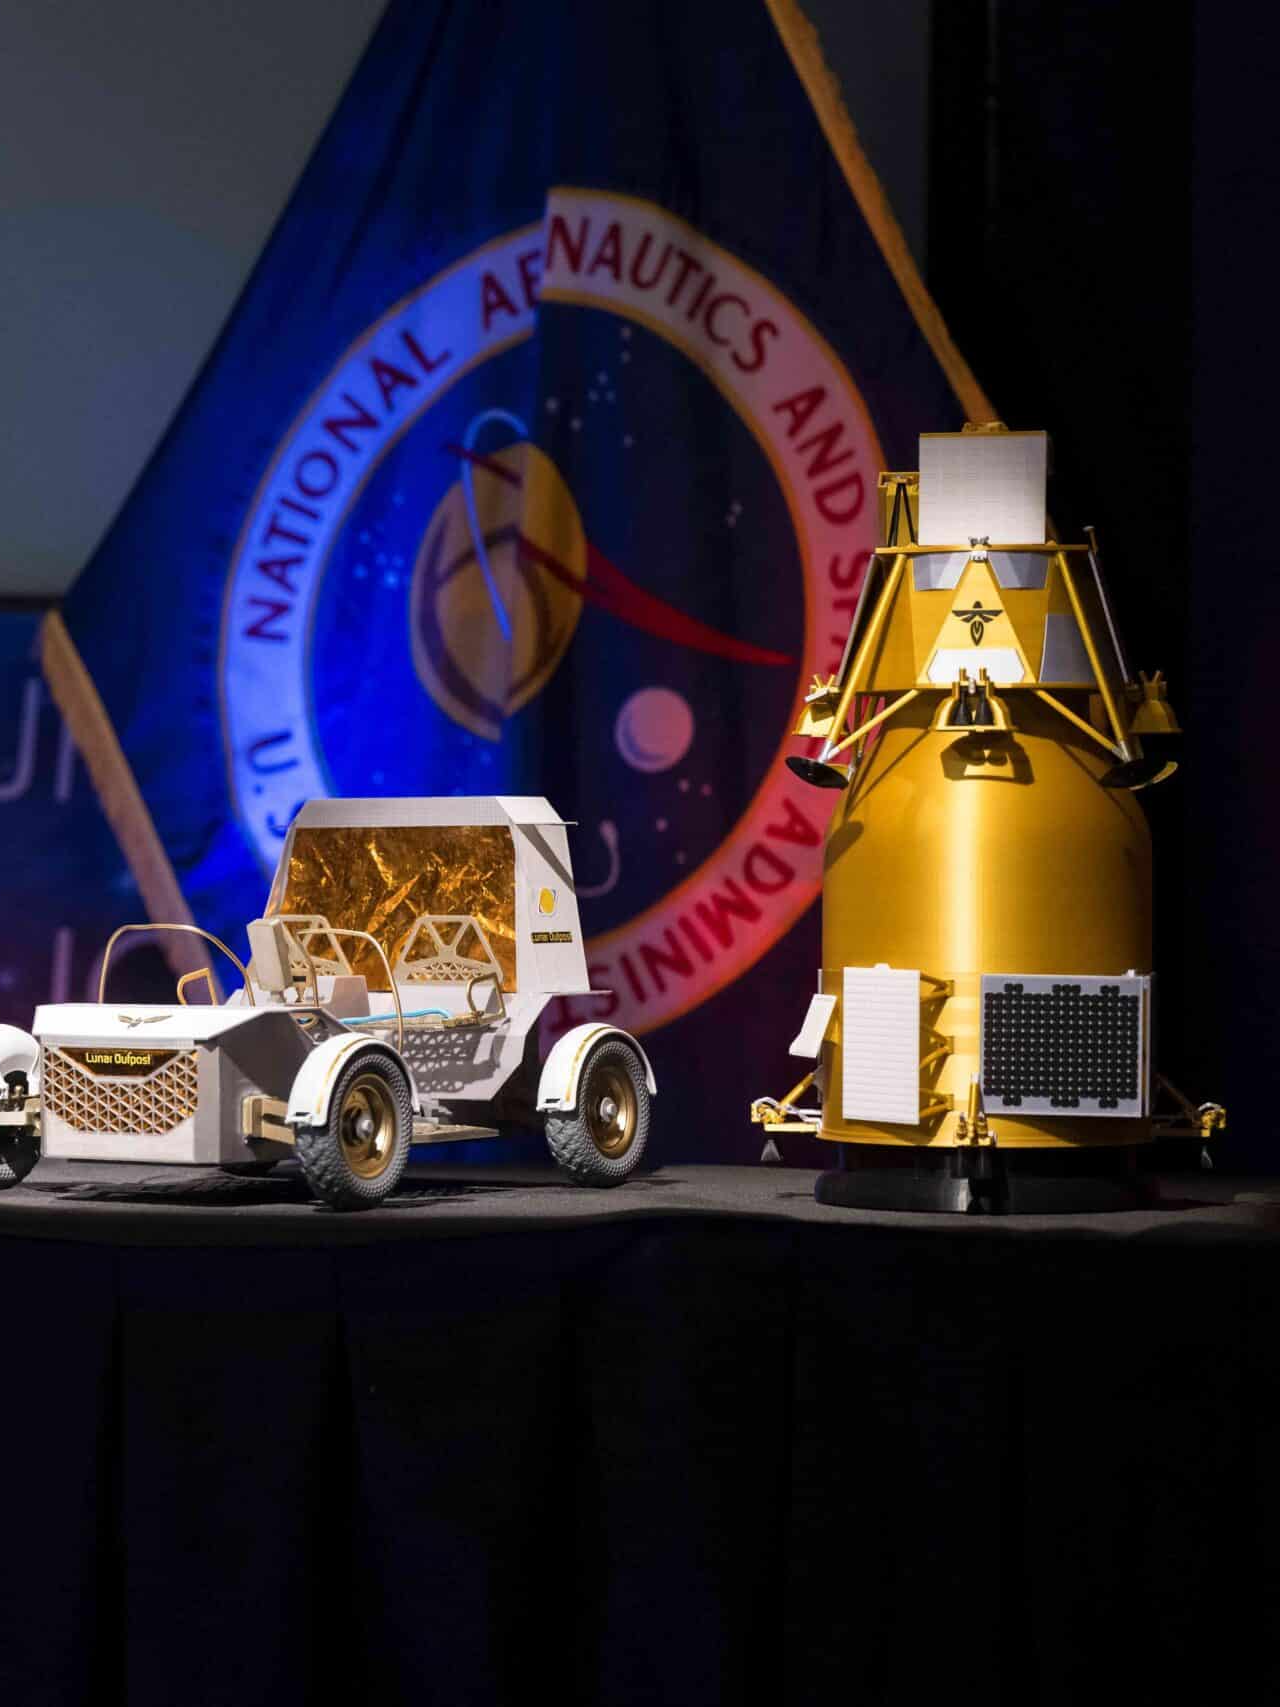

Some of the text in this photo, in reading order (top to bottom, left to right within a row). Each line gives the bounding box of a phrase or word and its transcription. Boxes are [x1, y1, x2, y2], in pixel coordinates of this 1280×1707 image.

[242, 329, 452, 642] NATIONAL
[774, 386, 865, 526] AND
[85, 1051, 113, 1064] Lunar
